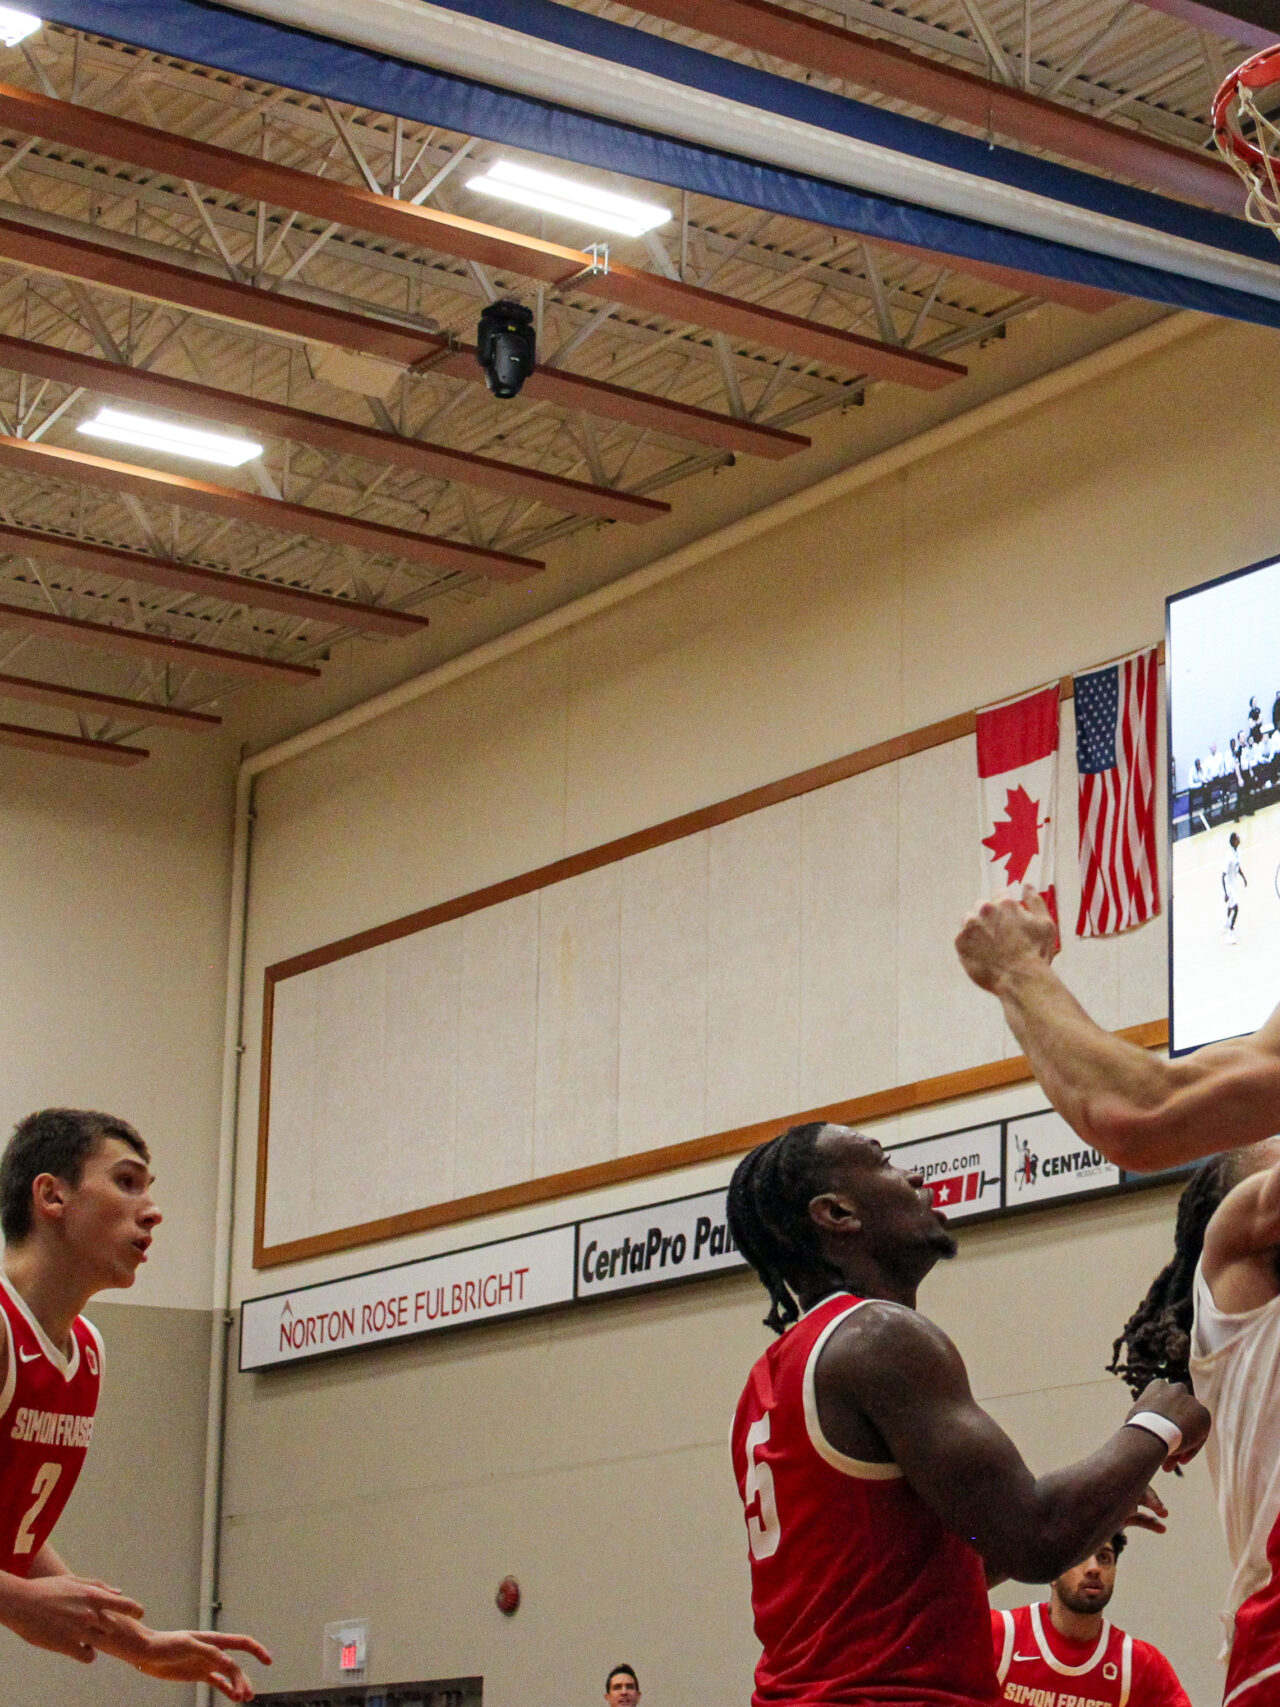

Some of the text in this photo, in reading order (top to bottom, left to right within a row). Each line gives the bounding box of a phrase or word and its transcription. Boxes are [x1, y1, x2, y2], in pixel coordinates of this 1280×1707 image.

[583, 1217, 738, 1284] CertaPro Pai
[279, 1267, 529, 1352] NORTON ROSE FULBRIGHT
[10, 1407, 94, 1448] SIMON FRASE
[14, 1462, 62, 1554] 2
[746, 1411, 781, 1561] 5
[1003, 1682, 1056, 1707] SIMON
